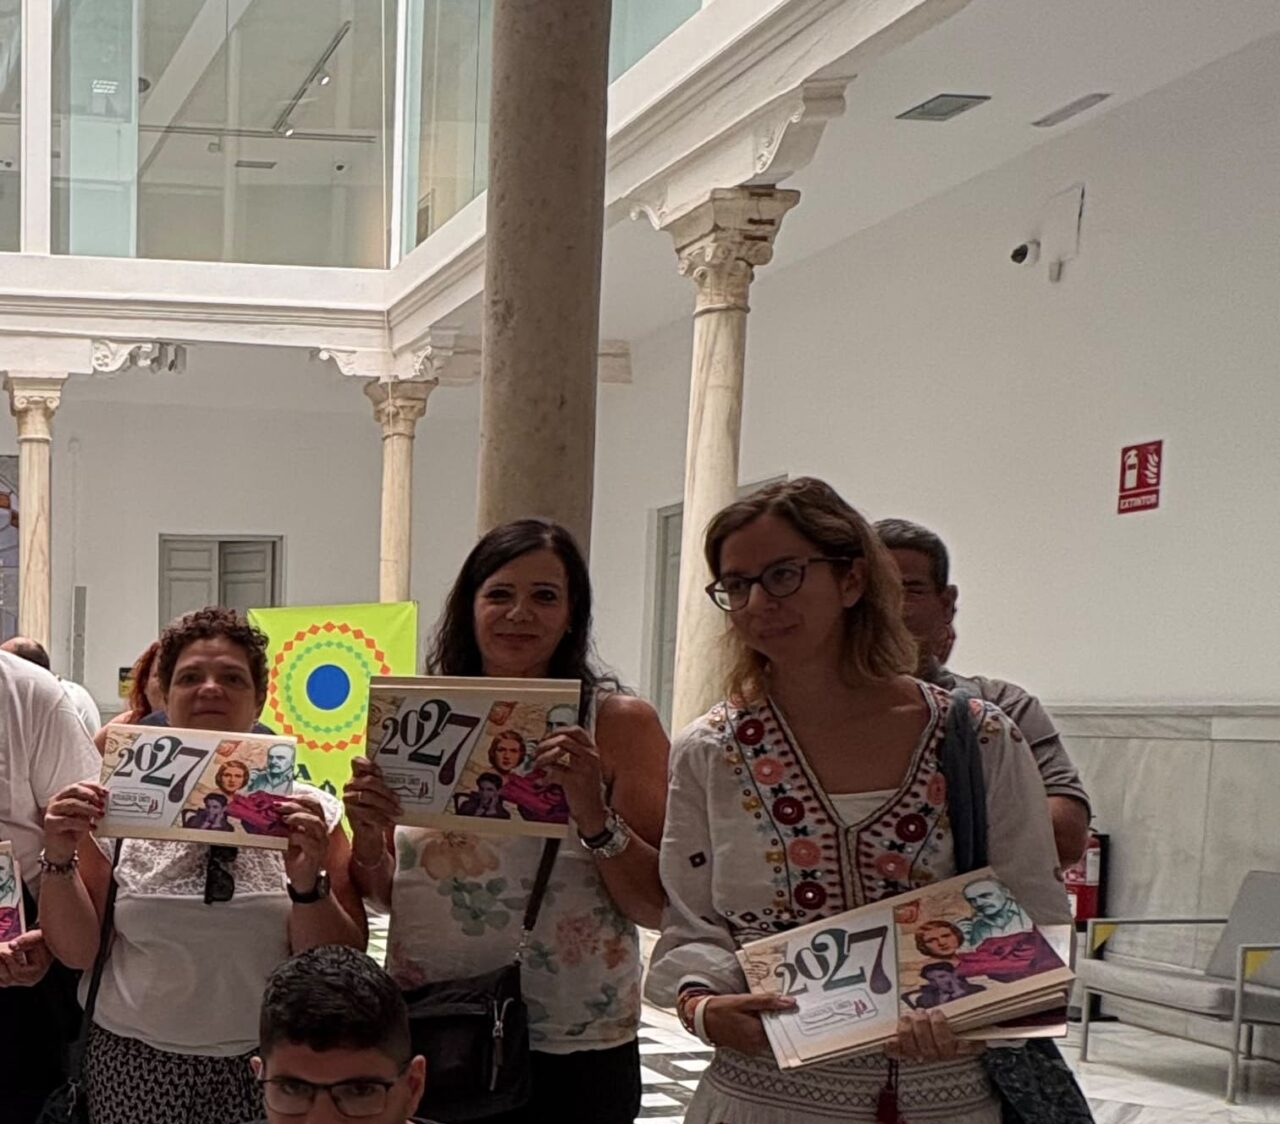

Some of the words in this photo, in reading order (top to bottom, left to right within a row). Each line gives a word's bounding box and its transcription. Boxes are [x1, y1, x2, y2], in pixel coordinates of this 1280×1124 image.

[114, 735, 209, 803] 2027
[380, 699, 481, 786] 2027
[775, 925, 893, 997] 2027
